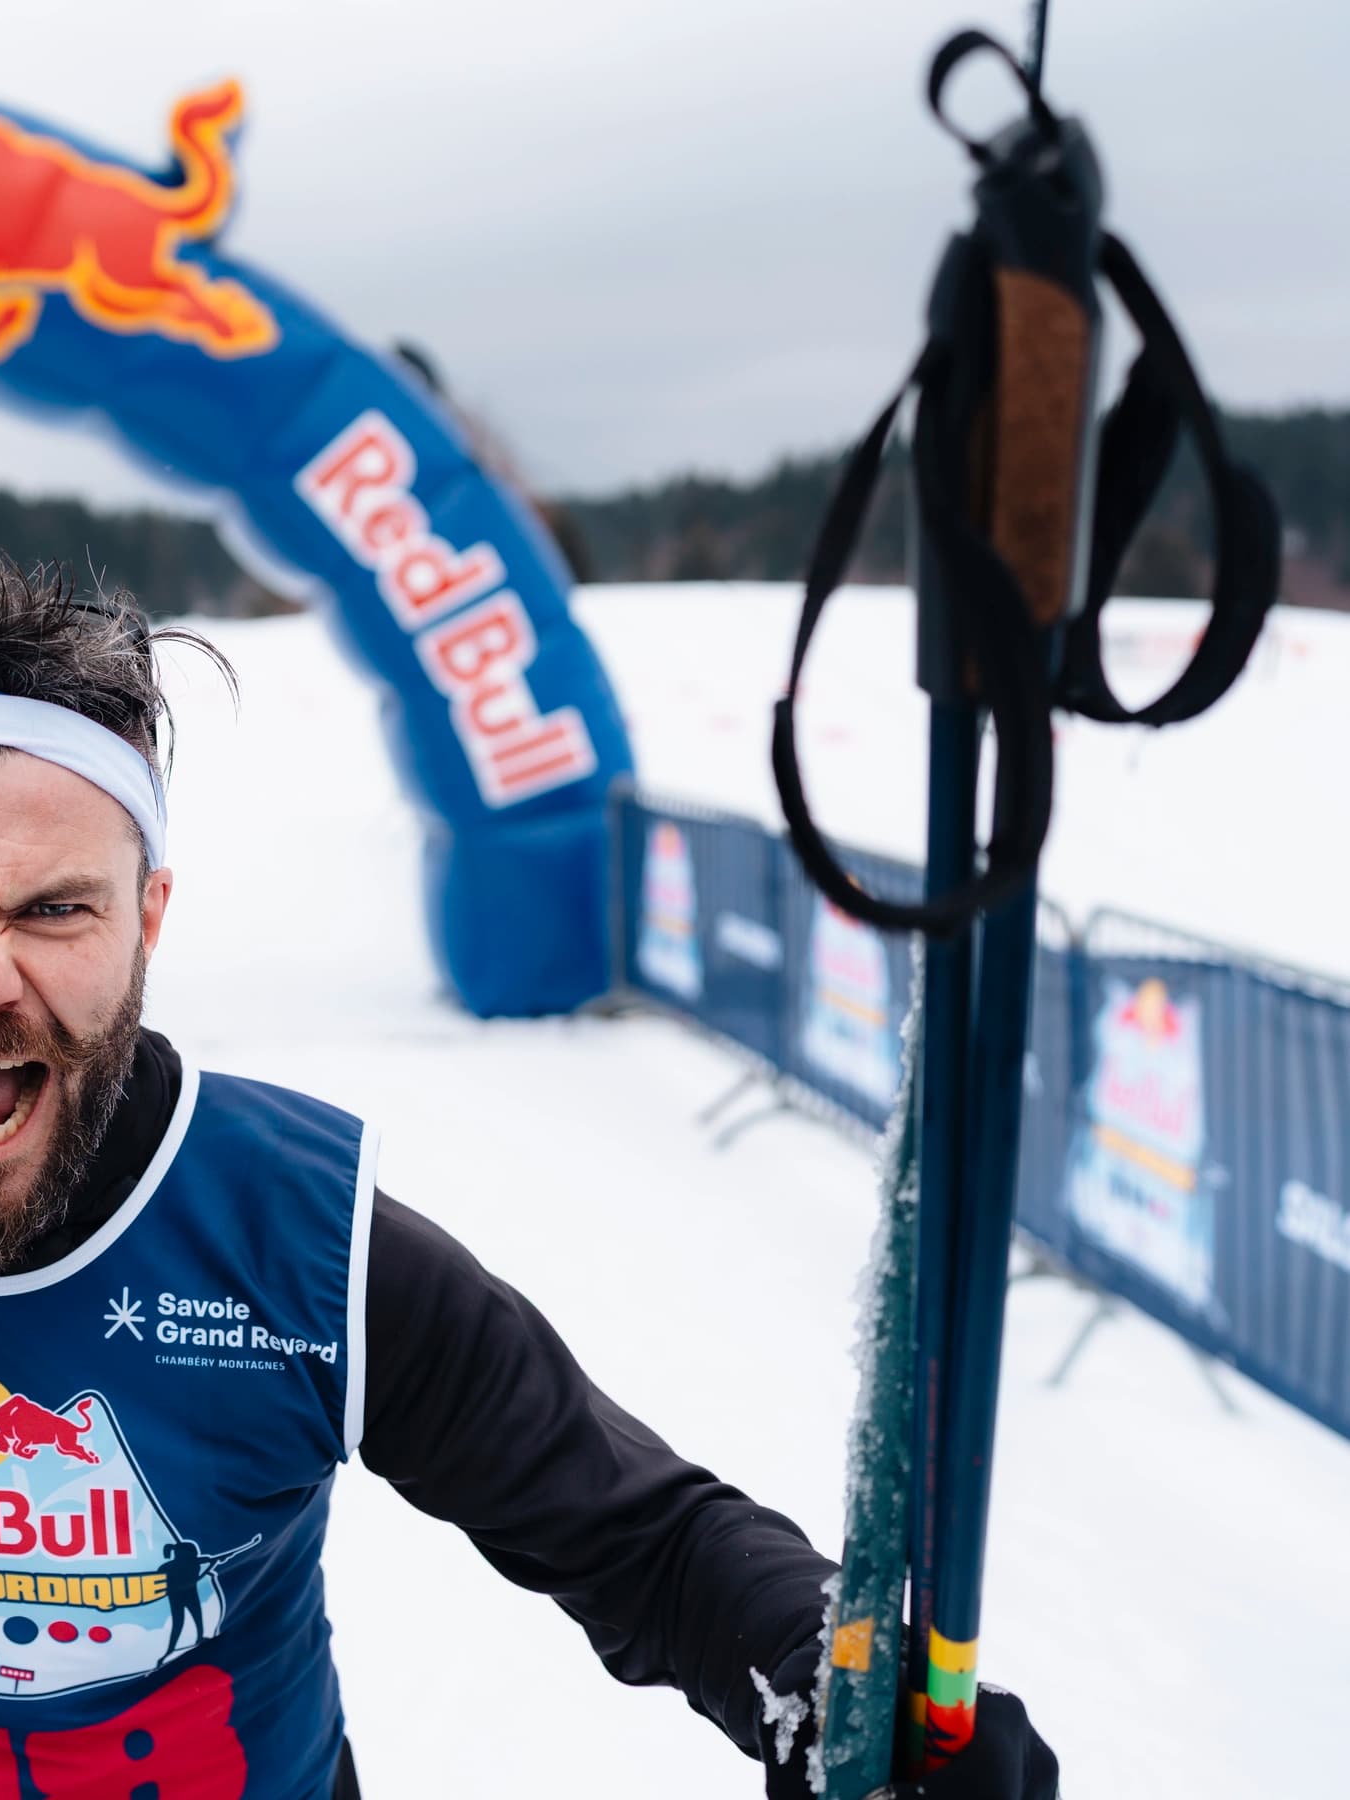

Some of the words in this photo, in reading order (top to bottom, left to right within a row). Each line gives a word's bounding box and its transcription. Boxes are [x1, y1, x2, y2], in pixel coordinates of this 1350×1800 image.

[310, 427, 492, 616] Red
[430, 607, 581, 795] Bull
[157, 1292, 250, 1320] Savoie
[156, 1320, 243, 1348] Grand
[251, 1325, 338, 1364] Revard
[155, 1354, 215, 1368] CHAMBÉRY
[218, 1359, 286, 1371] MONTAGNES
